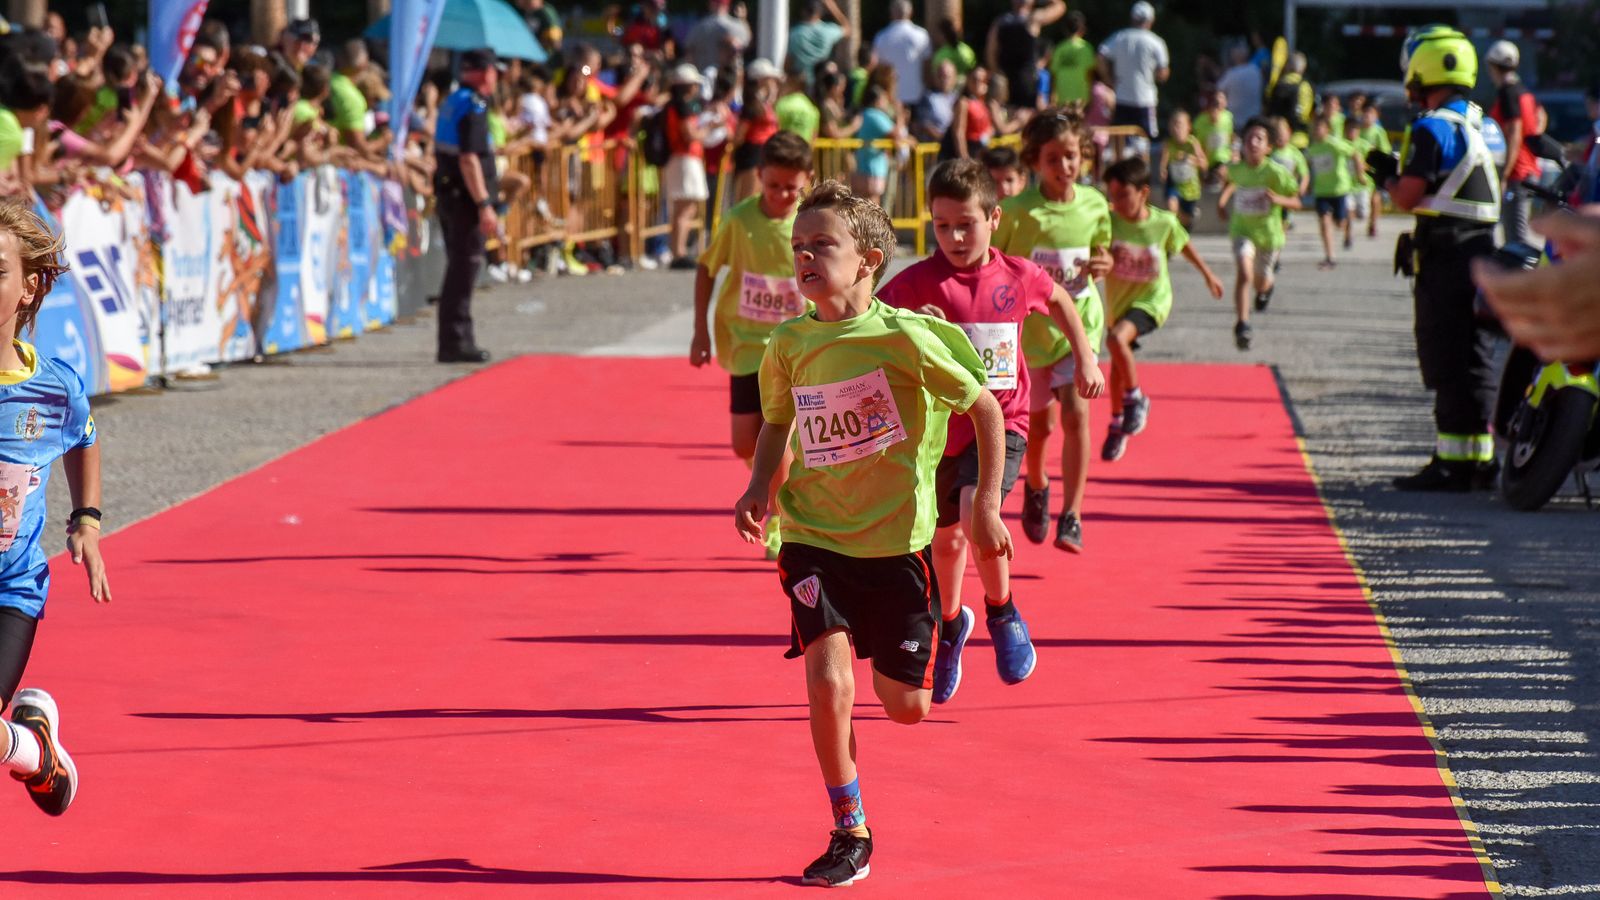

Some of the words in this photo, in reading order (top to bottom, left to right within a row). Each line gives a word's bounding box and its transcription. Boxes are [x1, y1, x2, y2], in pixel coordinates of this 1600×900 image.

[744, 289, 783, 310] 1498
[796, 394, 811, 407] XXI
[804, 410, 861, 444] 1240
